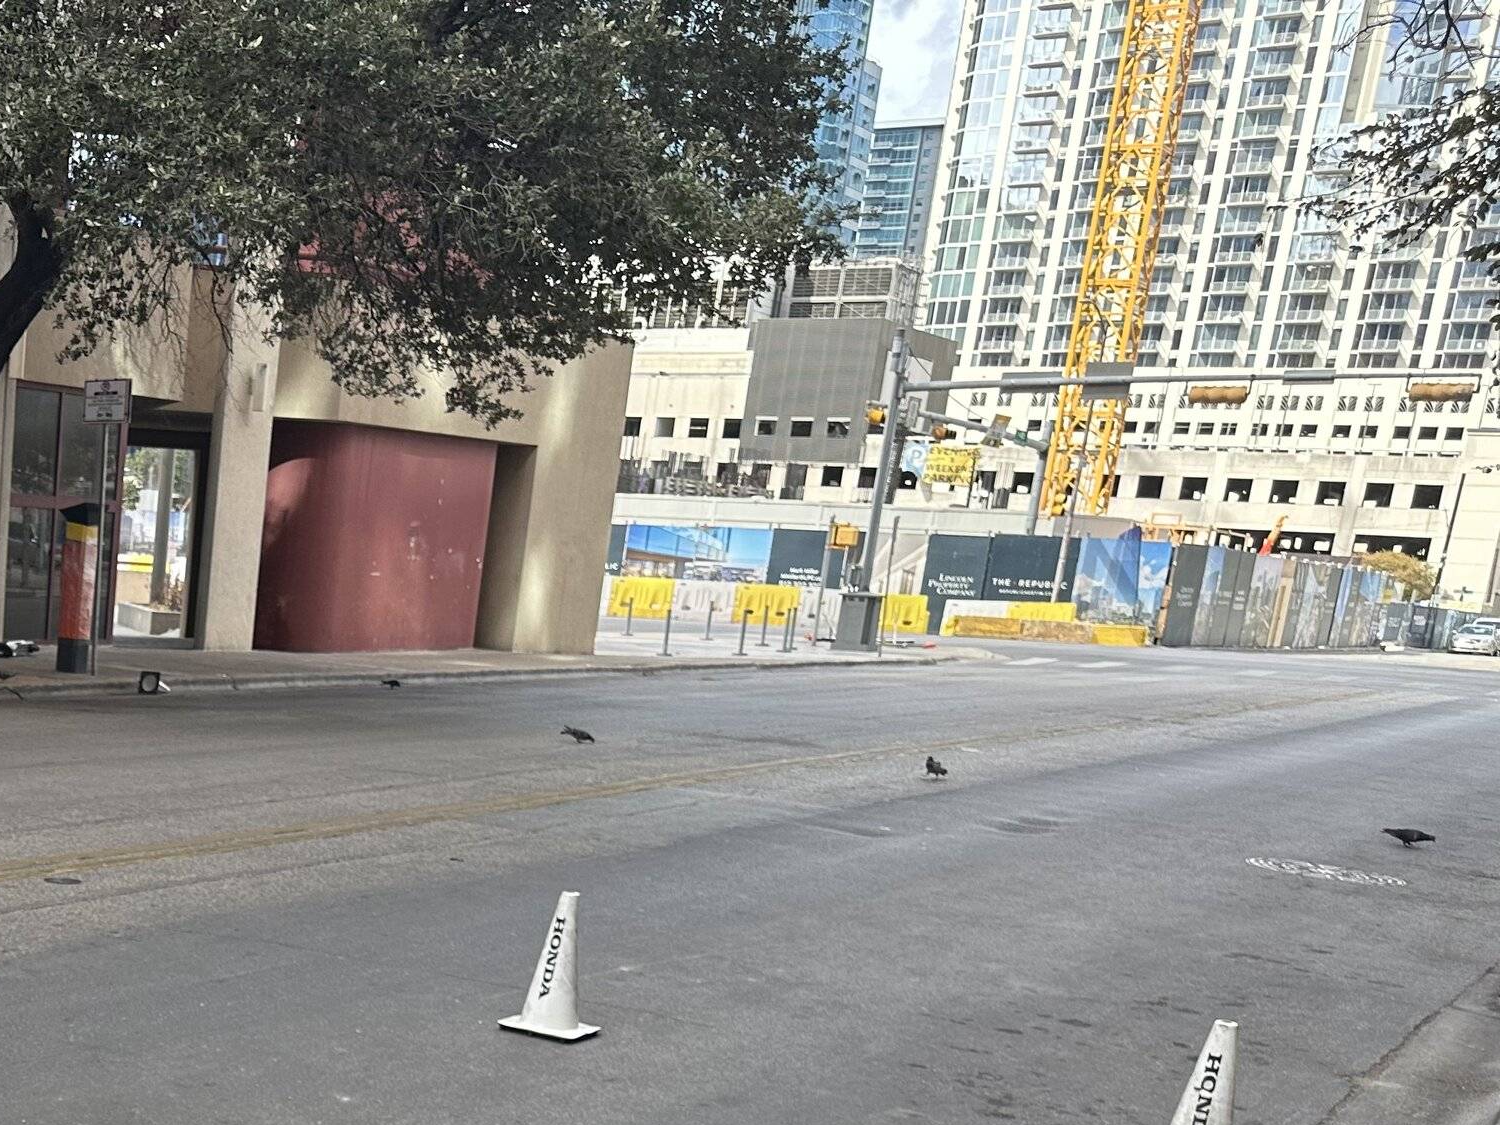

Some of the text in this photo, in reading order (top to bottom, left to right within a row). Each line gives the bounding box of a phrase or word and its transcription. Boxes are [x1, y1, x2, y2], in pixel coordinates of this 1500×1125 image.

[992, 577, 1068, 590] THE REPUBC
[538, 917, 566, 1000] HONDA
